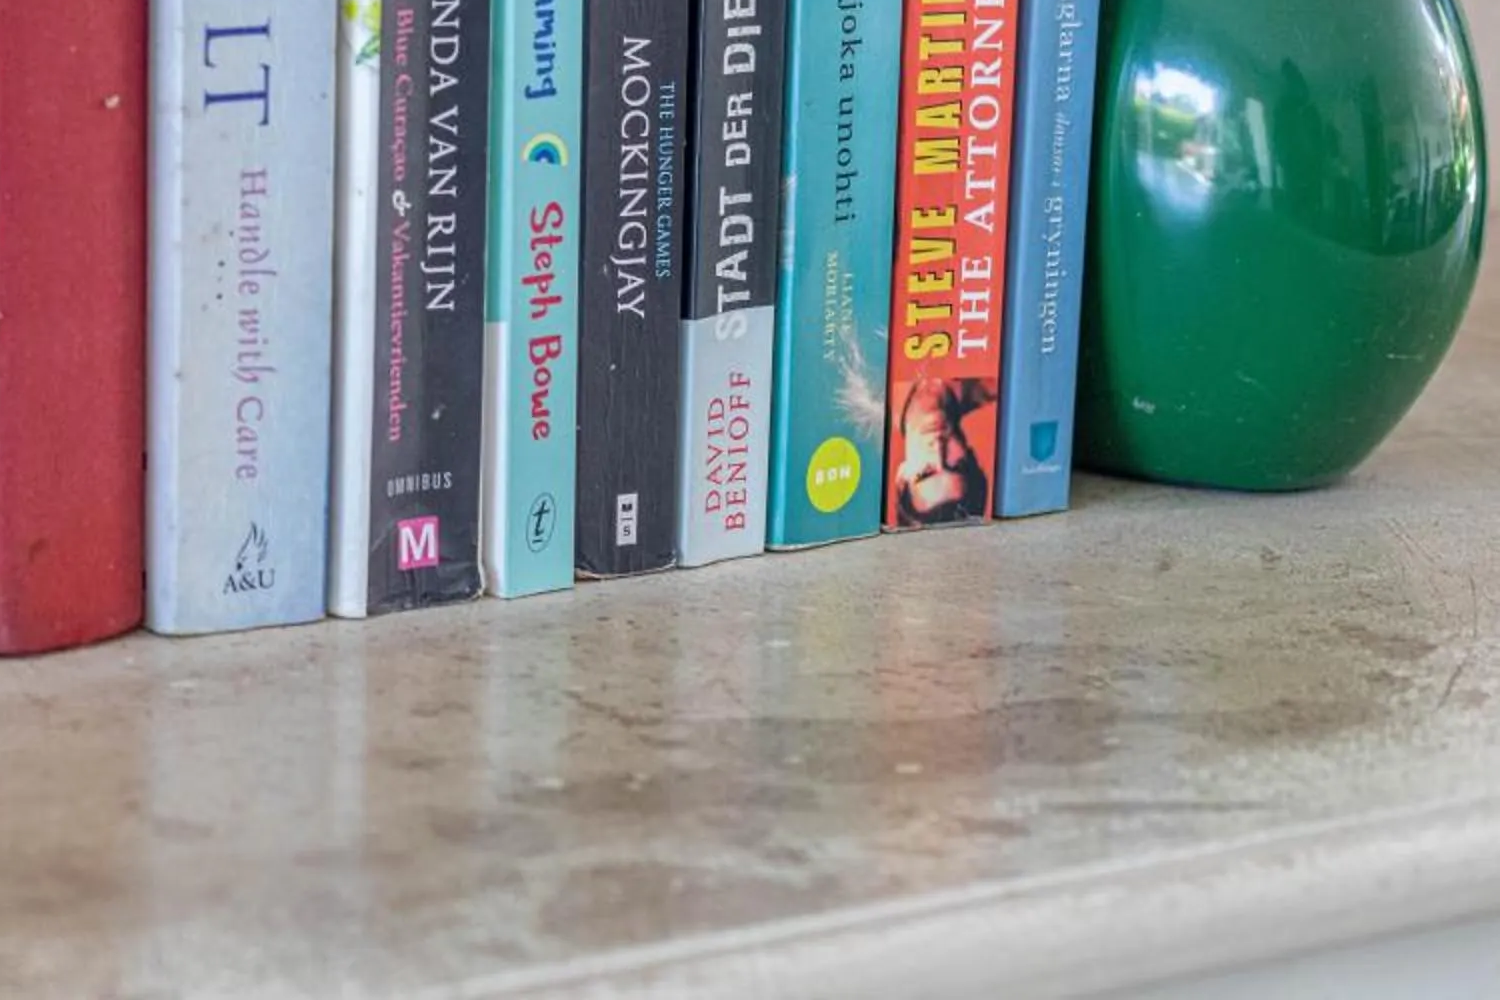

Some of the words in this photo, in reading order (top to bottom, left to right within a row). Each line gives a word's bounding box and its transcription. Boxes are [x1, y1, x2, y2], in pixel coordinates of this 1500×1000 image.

[396, 9, 415, 66] Blue
[658, 82, 676, 120] THE
[722, 91, 755, 168] DER
[428, 104, 459, 199] VAN
[609, 35, 653, 320] MOCKINGJAY
[657, 127, 675, 209] HUNGER
[833, 94, 859, 225] unohti
[237, 168, 278, 296] Handle
[419, 212, 457, 312] RIJN
[521, 200, 564, 320] Steph
[654, 213, 673, 279] GAMES
[716, 186, 754, 340] STADT
[905, 204, 958, 360] STEVE
[956, 256, 993, 359] THE
[234, 307, 277, 385] with
[528, 334, 563, 441] Bowe
[235, 396, 266, 481] Care
[387, 471, 454, 498] OMNIBUS
[704, 396, 726, 513] DAVID
[724, 370, 753, 532] BENIOFF
[222, 567, 277, 596] A&U
[401, 522, 439, 563] M
